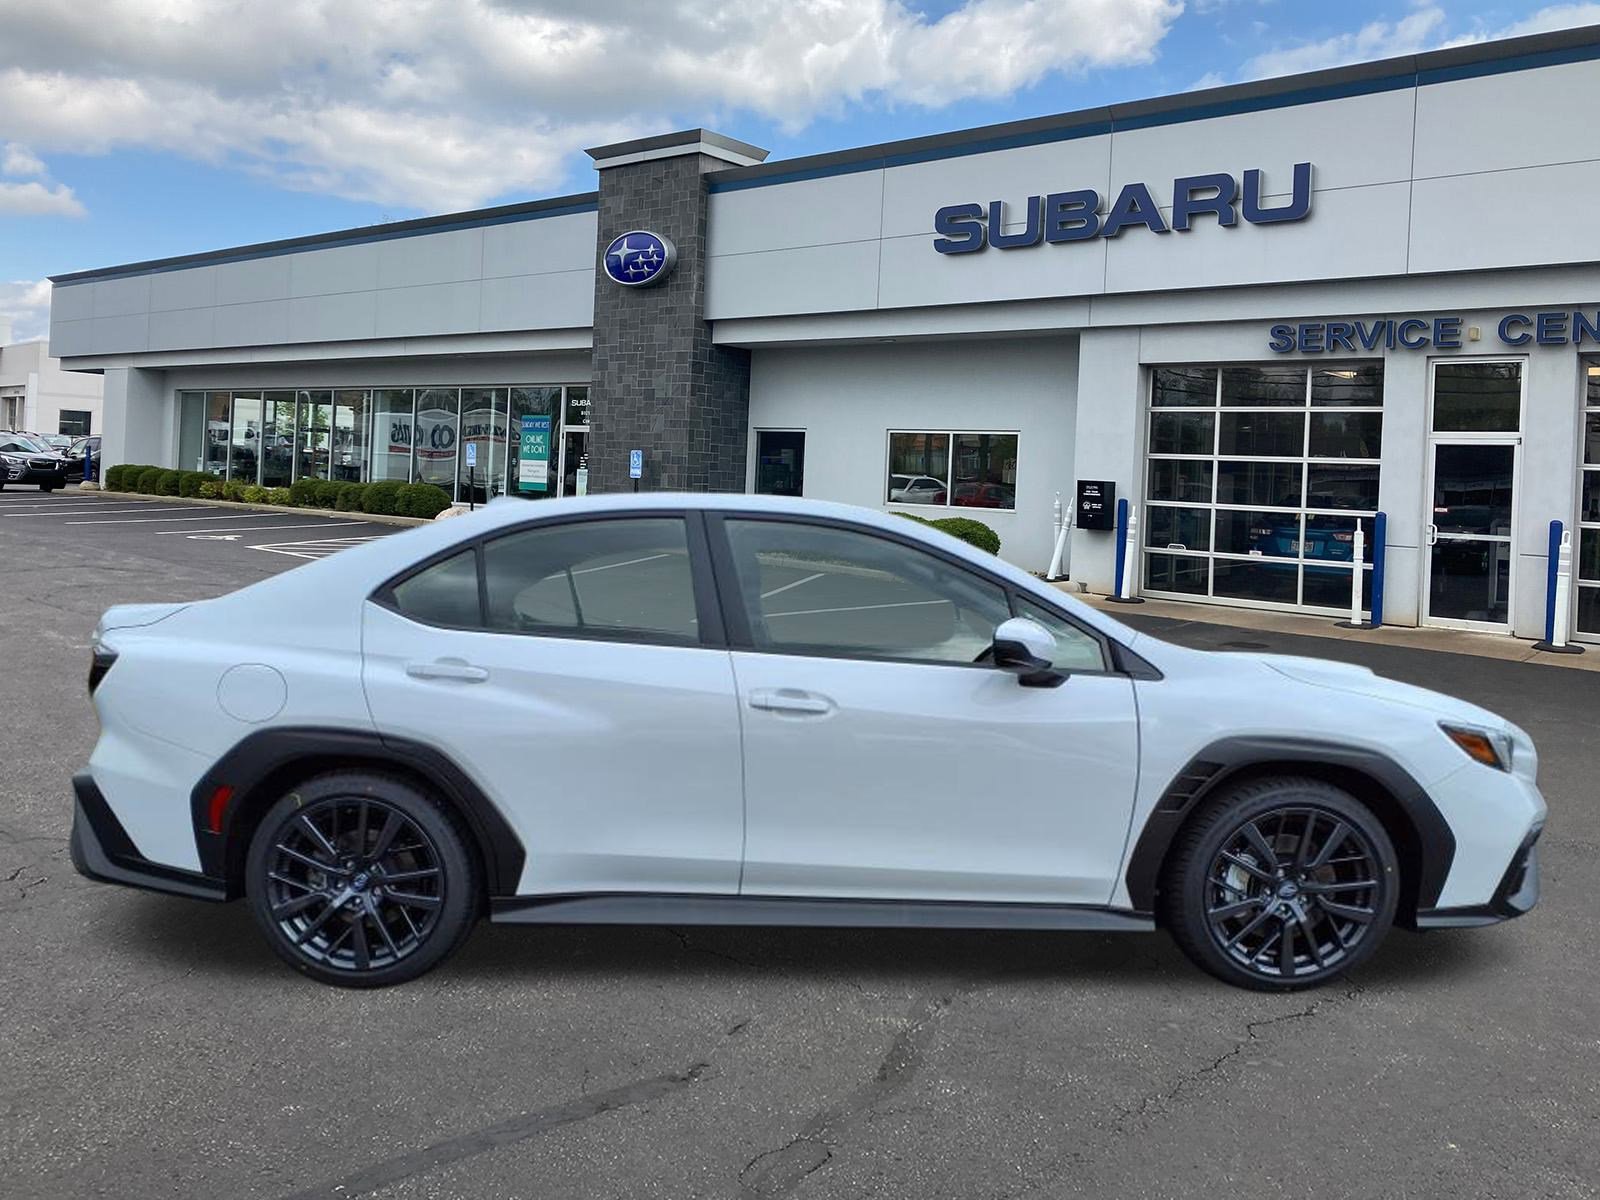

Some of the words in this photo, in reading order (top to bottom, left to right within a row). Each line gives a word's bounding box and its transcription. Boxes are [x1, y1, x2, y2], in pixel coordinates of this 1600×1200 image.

[933, 162, 1314, 255] SUBARU
[1269, 318, 1464, 351] SERVICE
[1498, 311, 1600, 346] CEN
